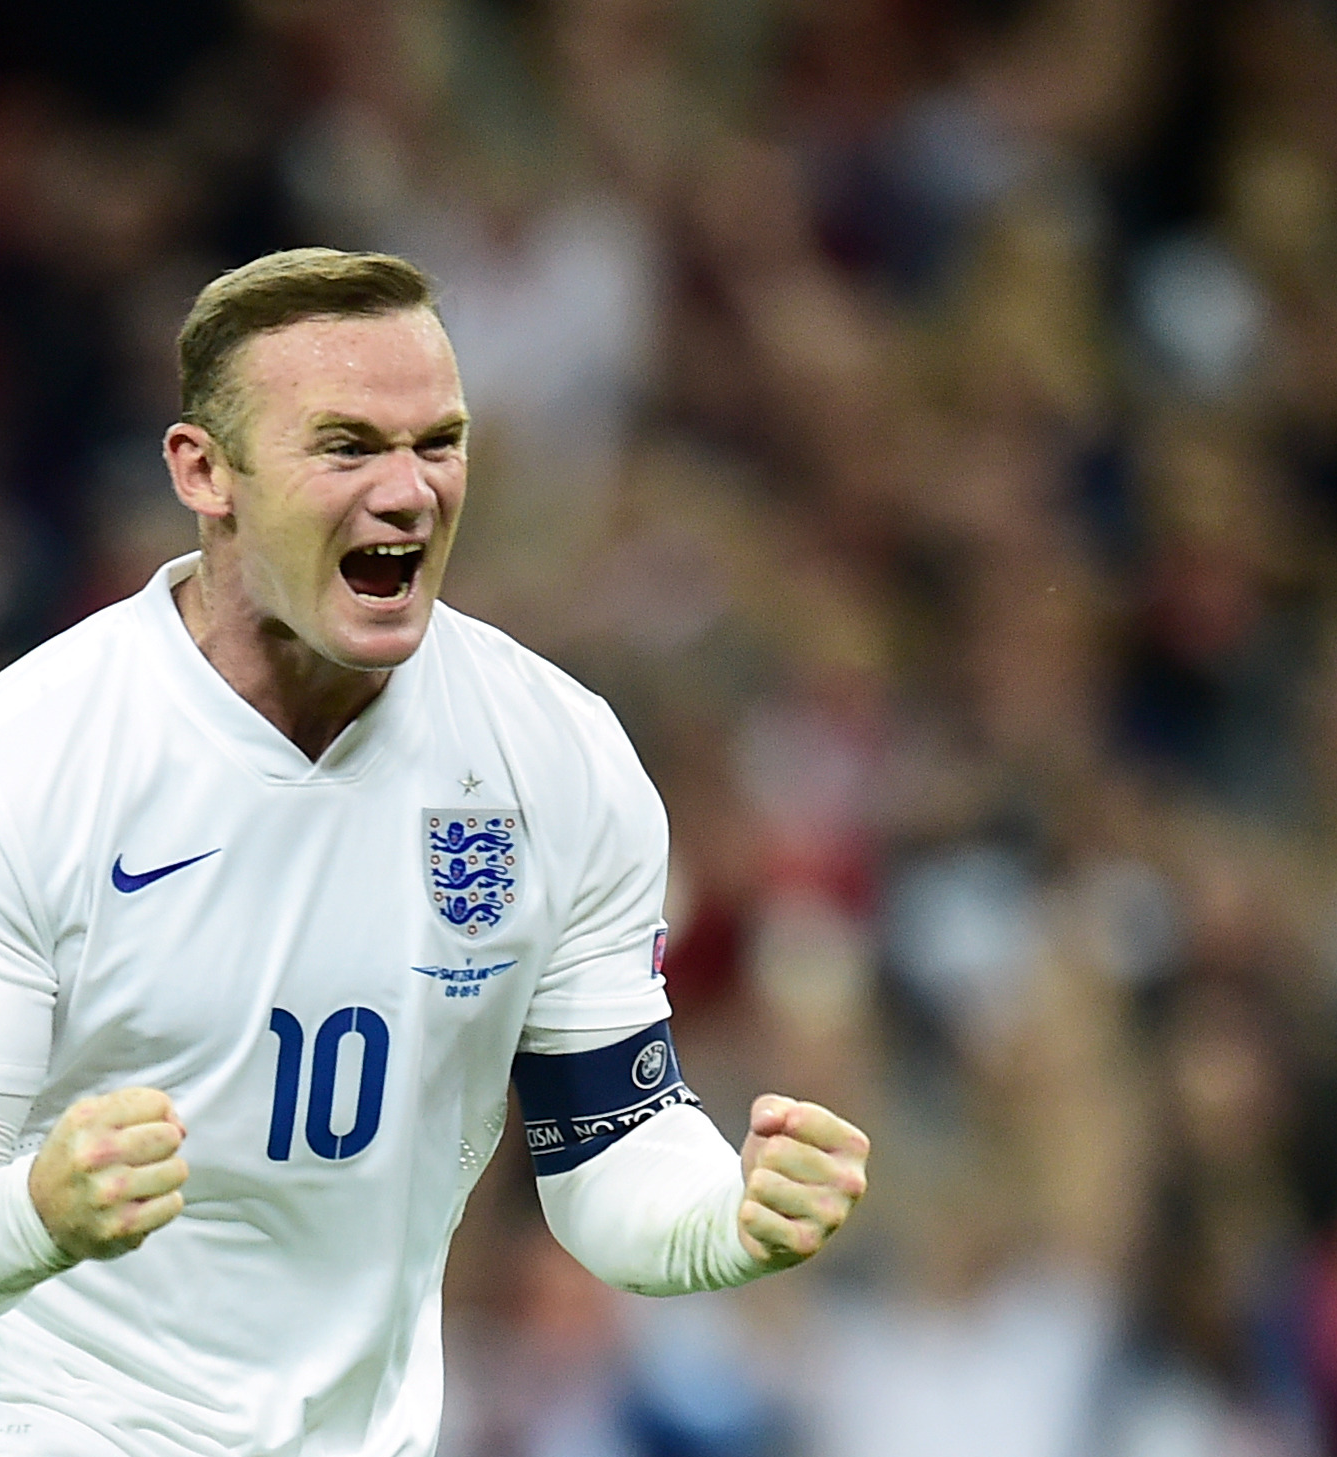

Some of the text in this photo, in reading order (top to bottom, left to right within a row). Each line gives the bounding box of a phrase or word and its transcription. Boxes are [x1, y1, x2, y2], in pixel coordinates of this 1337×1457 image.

[267, 1006, 389, 1161] 10
[573, 1120, 615, 1138] NO
[616, 1107, 657, 1125] TO
